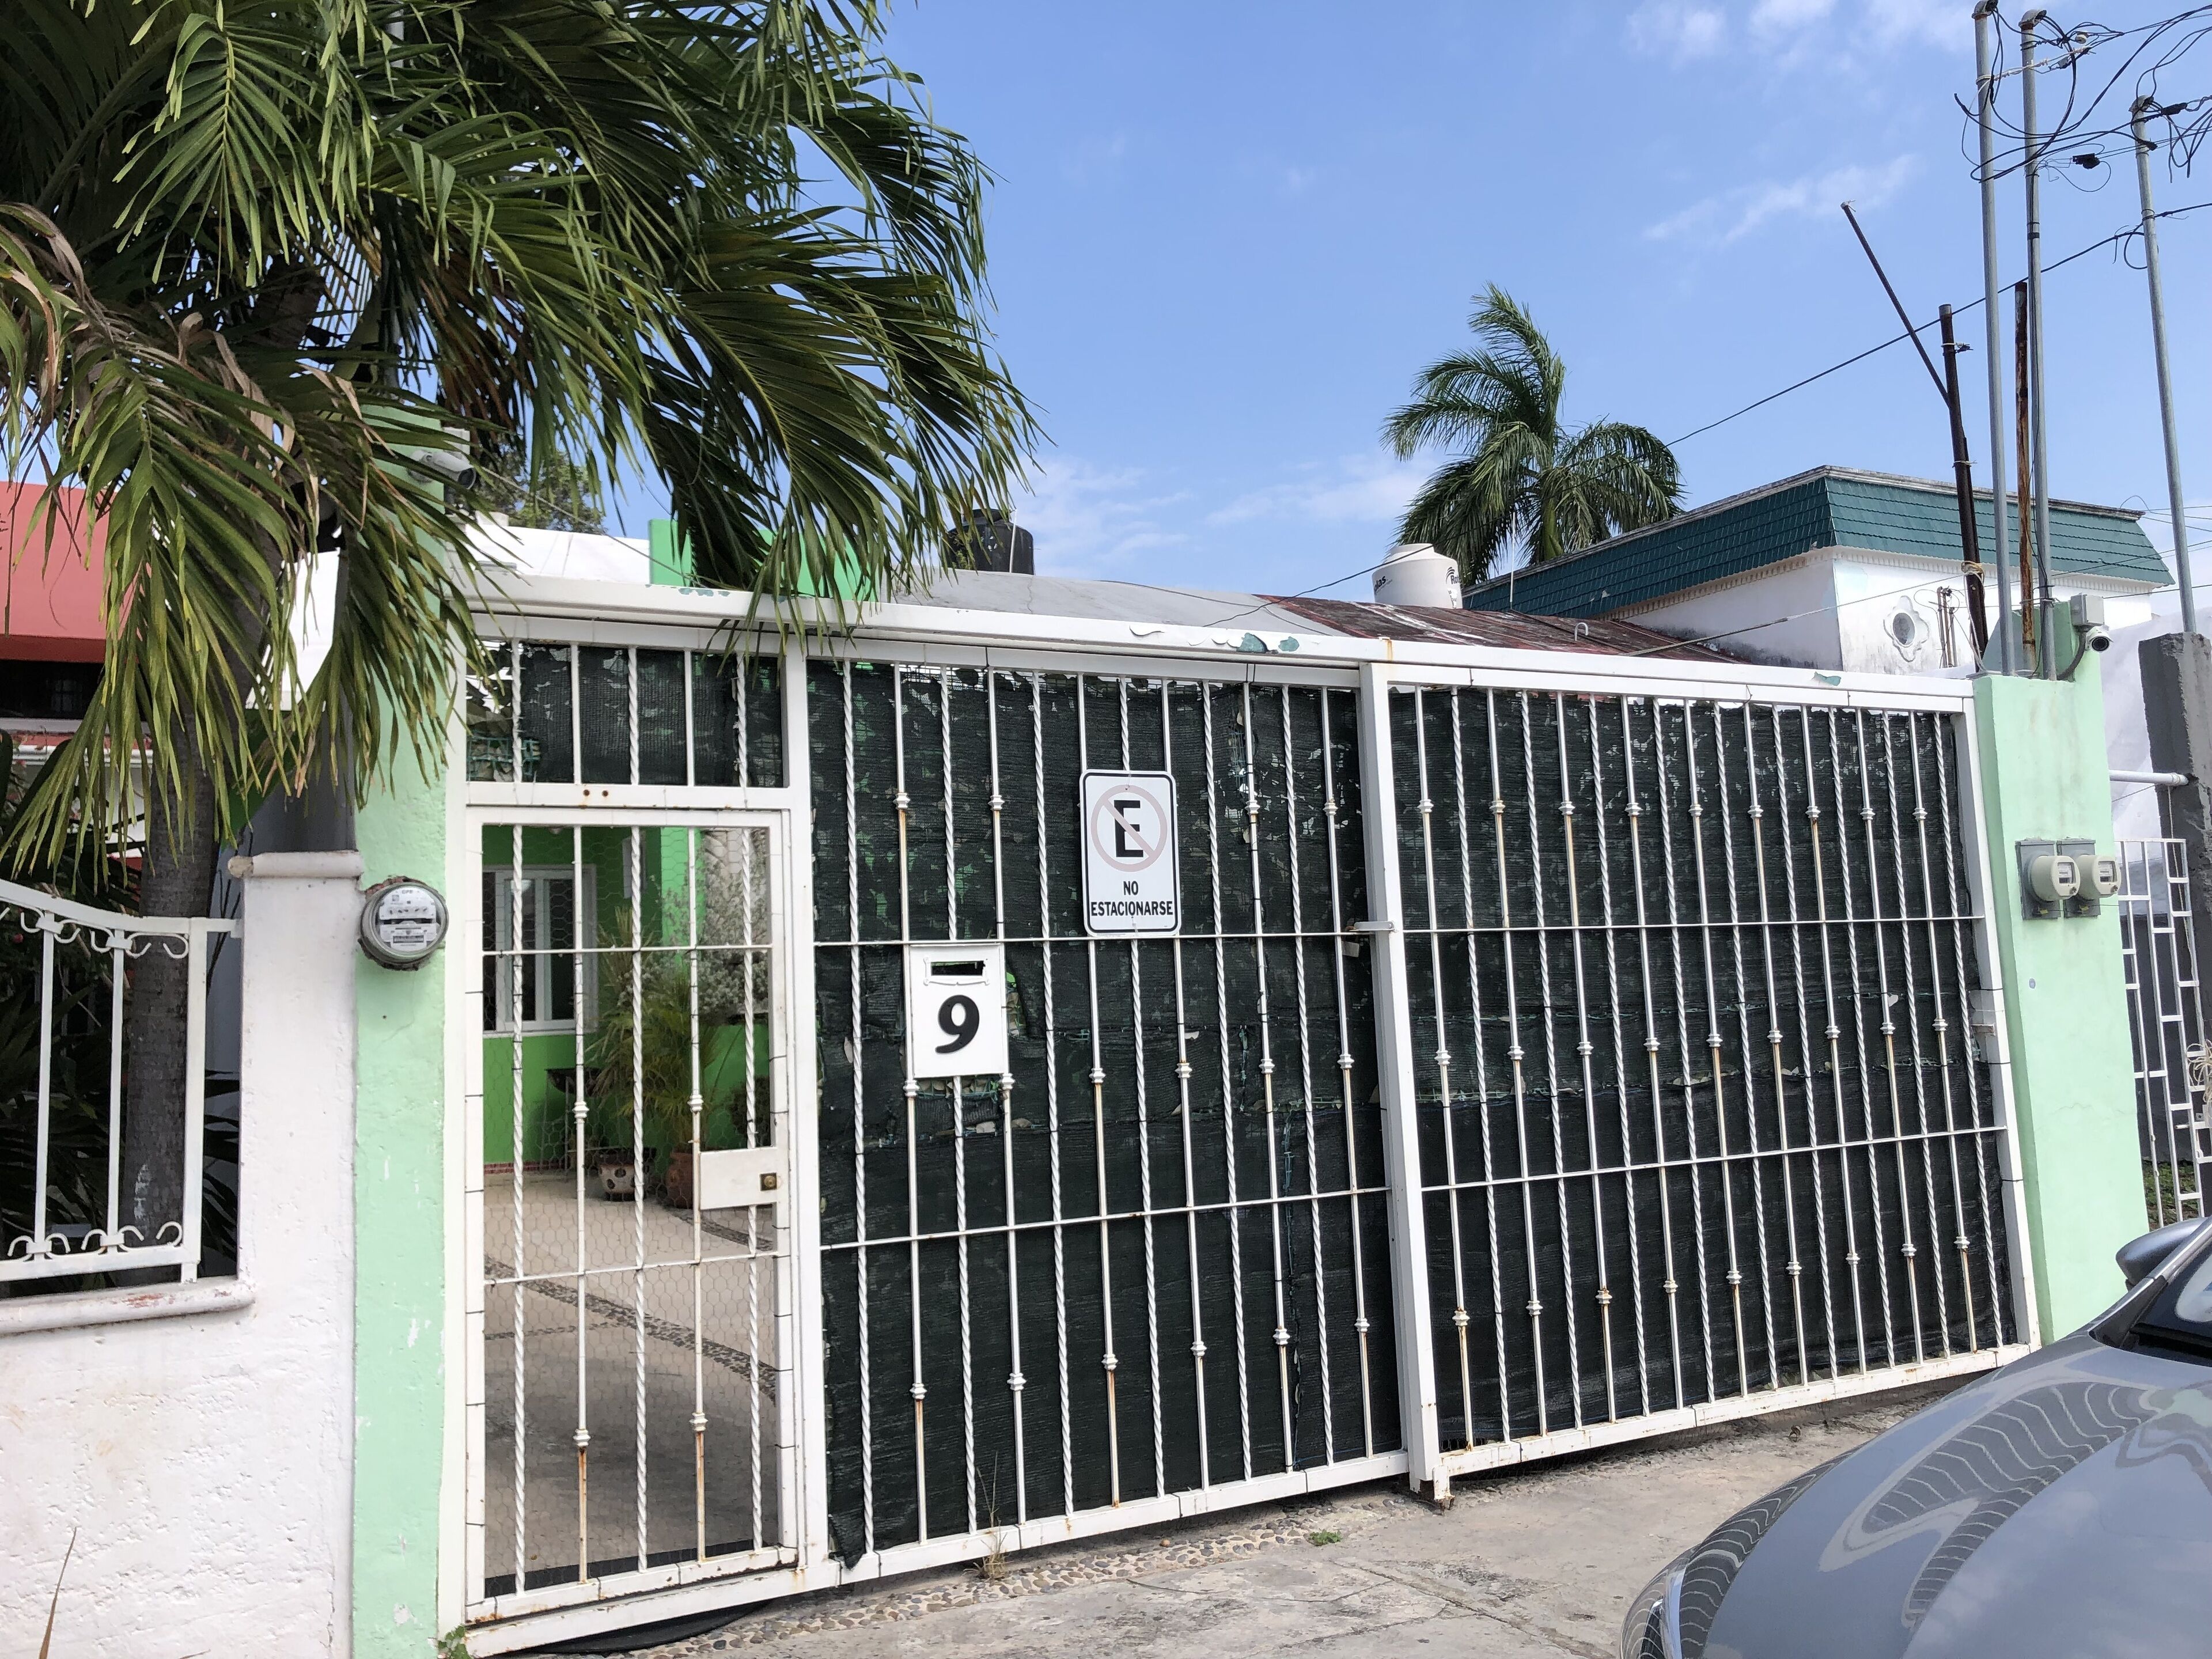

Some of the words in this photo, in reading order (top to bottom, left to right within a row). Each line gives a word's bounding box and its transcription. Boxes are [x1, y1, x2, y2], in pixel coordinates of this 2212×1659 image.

[1113, 800, 1144, 858] E
[1123, 881, 1138, 896] NO
[1090, 900, 1173, 916] ESTACIONARSE
[935, 994, 979, 1054] 9
